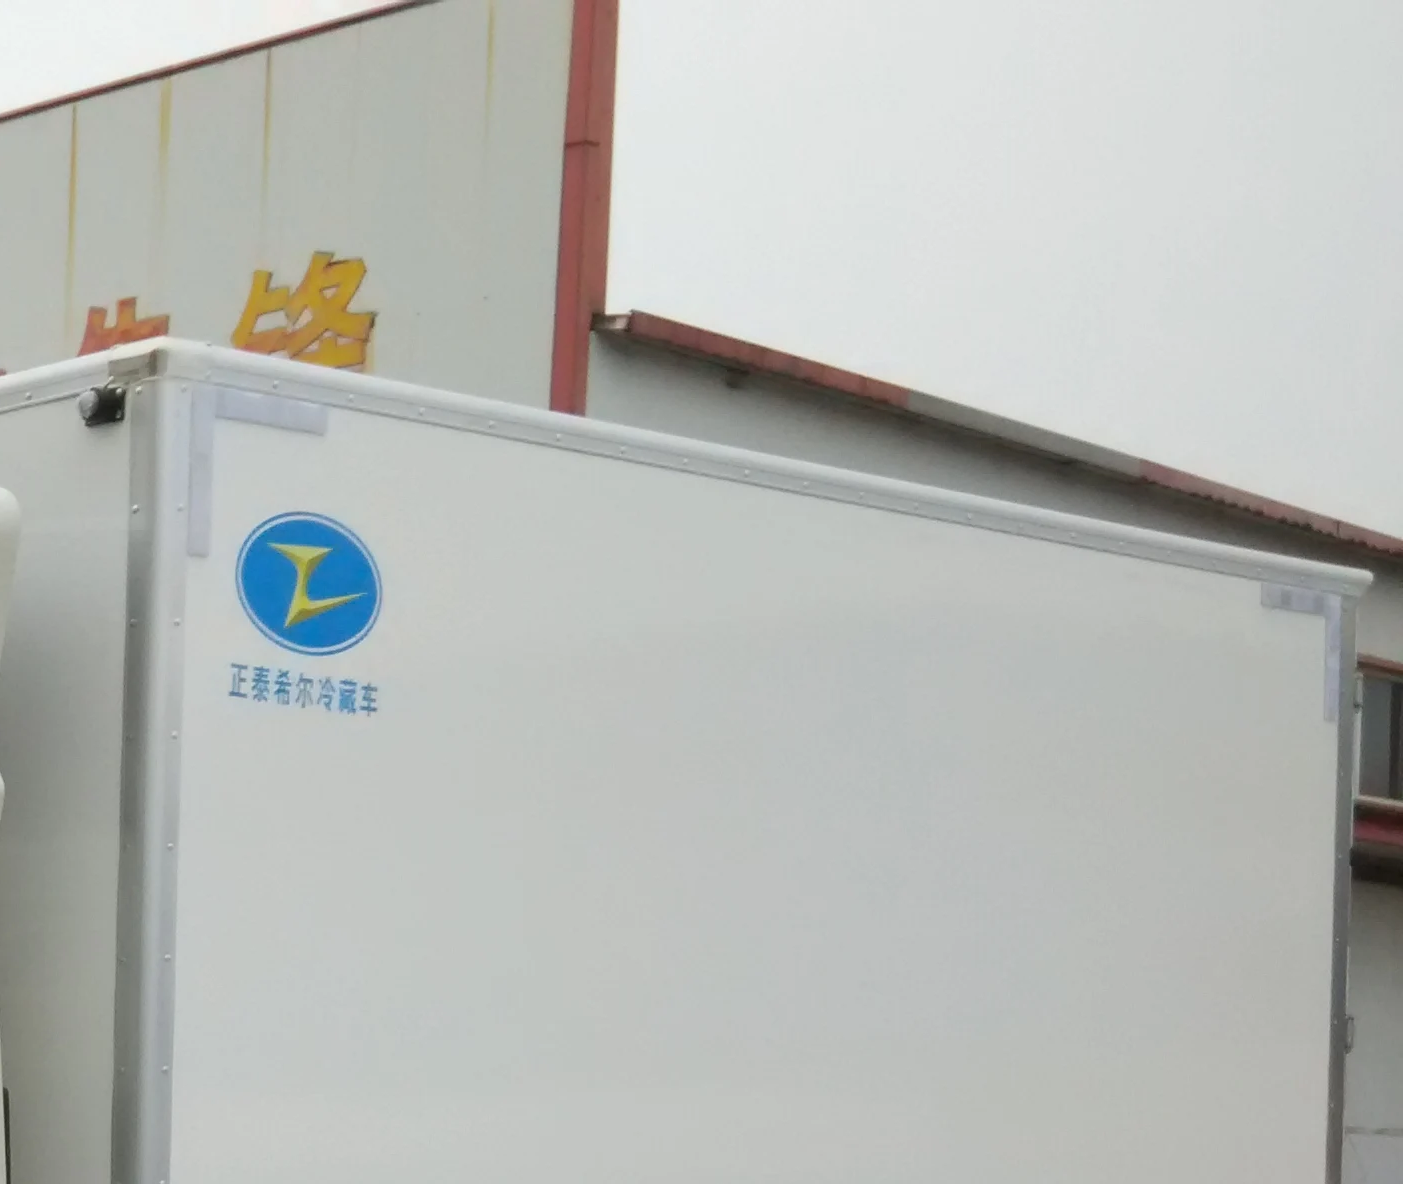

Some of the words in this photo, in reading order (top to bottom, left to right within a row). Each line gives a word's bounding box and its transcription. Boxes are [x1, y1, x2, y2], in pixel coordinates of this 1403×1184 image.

[228, 663, 379, 717] 正泰希尔冷藏车
